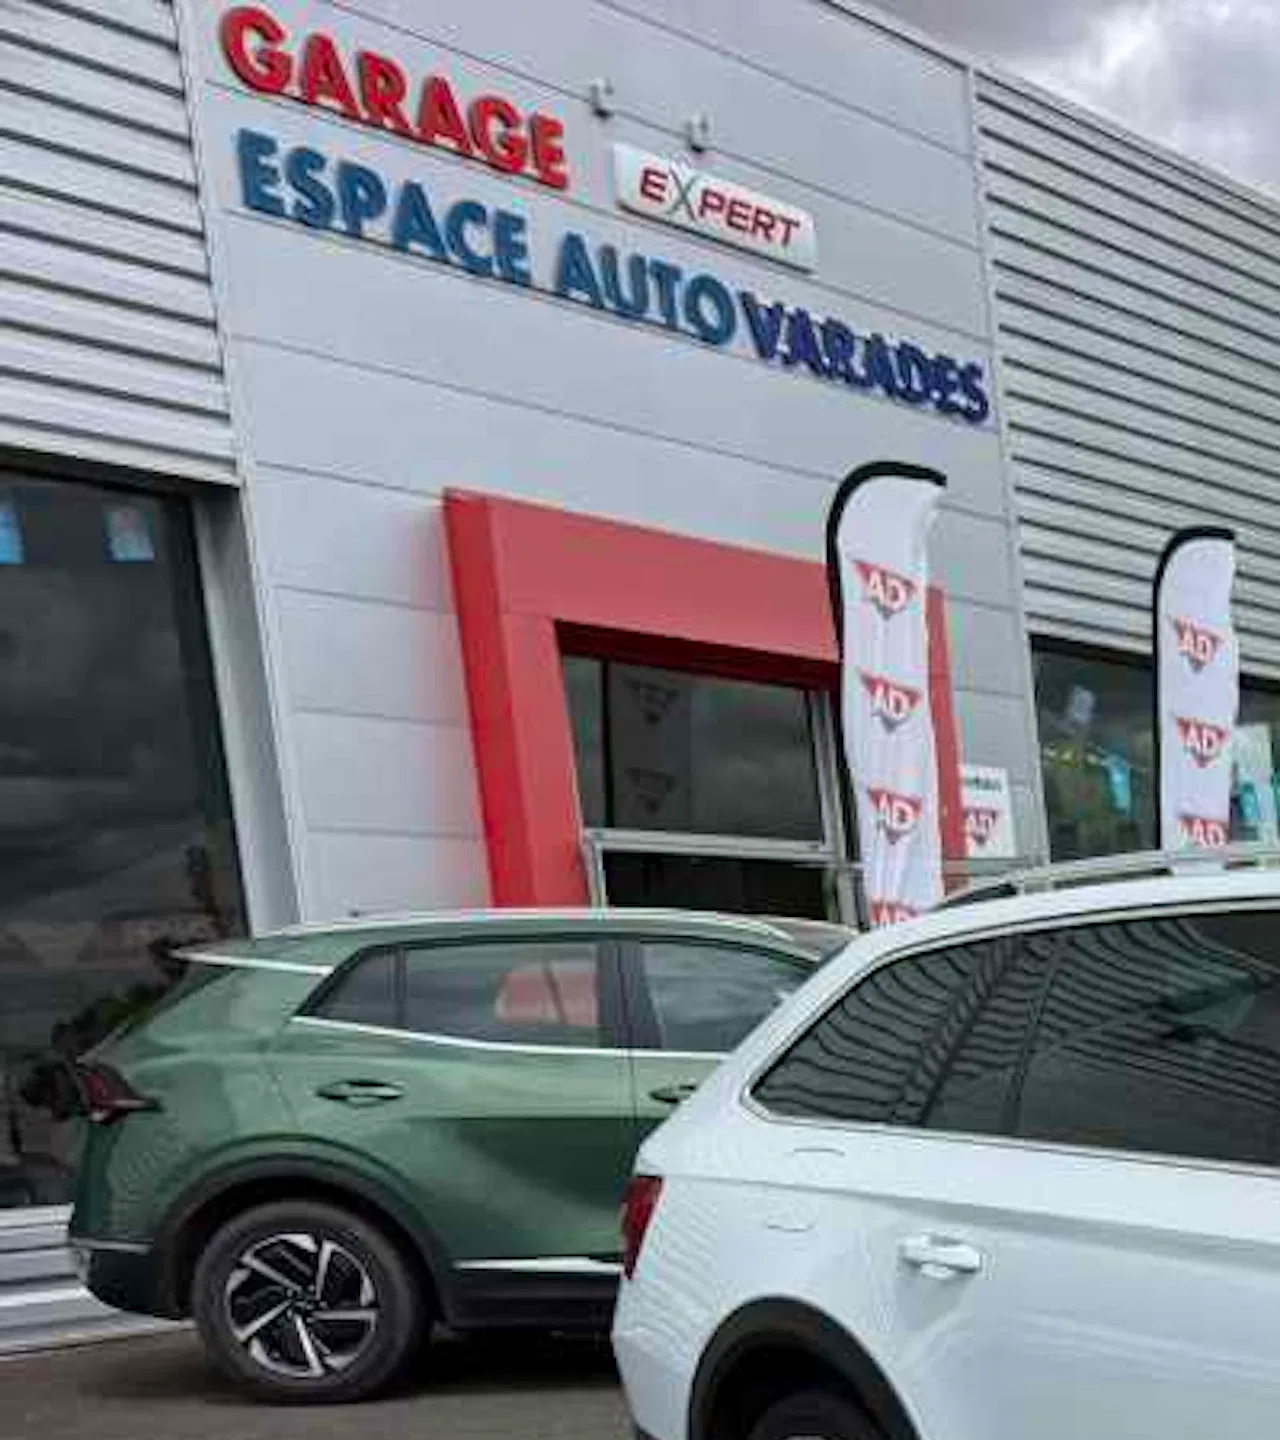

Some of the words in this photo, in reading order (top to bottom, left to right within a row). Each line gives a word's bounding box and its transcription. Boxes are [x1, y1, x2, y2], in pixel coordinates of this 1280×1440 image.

[219, 6, 569, 191] GARAGE
[637, 162, 801, 248] EXPERT
[236, 128, 531, 287] ESPACE
[554, 232, 737, 347] AUTO
[738, 291, 989, 424] VARADES
[868, 572, 908, 608] AD
[1175, 630, 1214, 661] AD
[873, 688, 912, 719] AD
[1185, 725, 1219, 753] AD
[876, 793, 914, 828] AD
